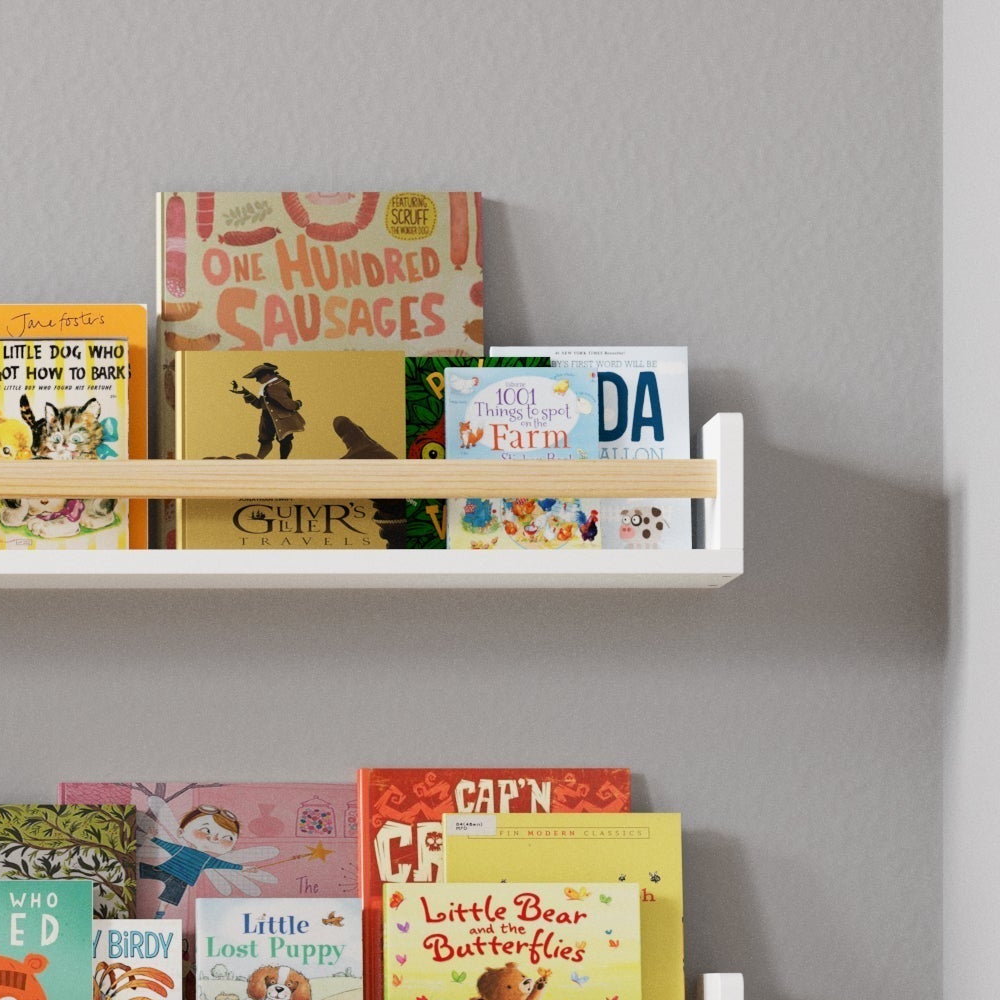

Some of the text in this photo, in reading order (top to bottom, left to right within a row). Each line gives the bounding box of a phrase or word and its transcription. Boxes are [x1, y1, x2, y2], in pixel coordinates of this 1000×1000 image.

[391, 196, 428, 208] FEATURING
[391, 208, 430, 226] SCRUFF
[202, 235, 440, 291] ONE HUNDRED
[6, 313, 56, 338] Jane
[216, 287, 446, 350] SAUSAGES
[3, 345, 42, 360] LITTLE
[50, 345, 81, 360] DOG
[88, 345, 124, 360] WHO
[26, 365, 63, 380] HOW
[69, 366, 86, 380] TO
[551, 360, 658, 368] BY'S FIRST WORD WILL BE
[495, 388, 536, 405] 1001
[474, 401, 571, 422] Things to spot
[597, 371, 665, 442] DA
[533, 419, 547, 428] the
[489, 423, 570, 451] Farm
[599, 447, 665, 460] ALLON
[238, 537, 371, 546] TRAVELS
[454, 778, 551, 813] CAP'N
[296, 875, 319, 894] The
[9, 892, 58, 909] WHO
[420, 892, 587, 924] Little Bear
[242, 913, 310, 935] Little
[469, 923, 526, 934] and the
[205, 936, 347, 965] Lost Puppy
[423, 928, 586, 964] Butterflies
